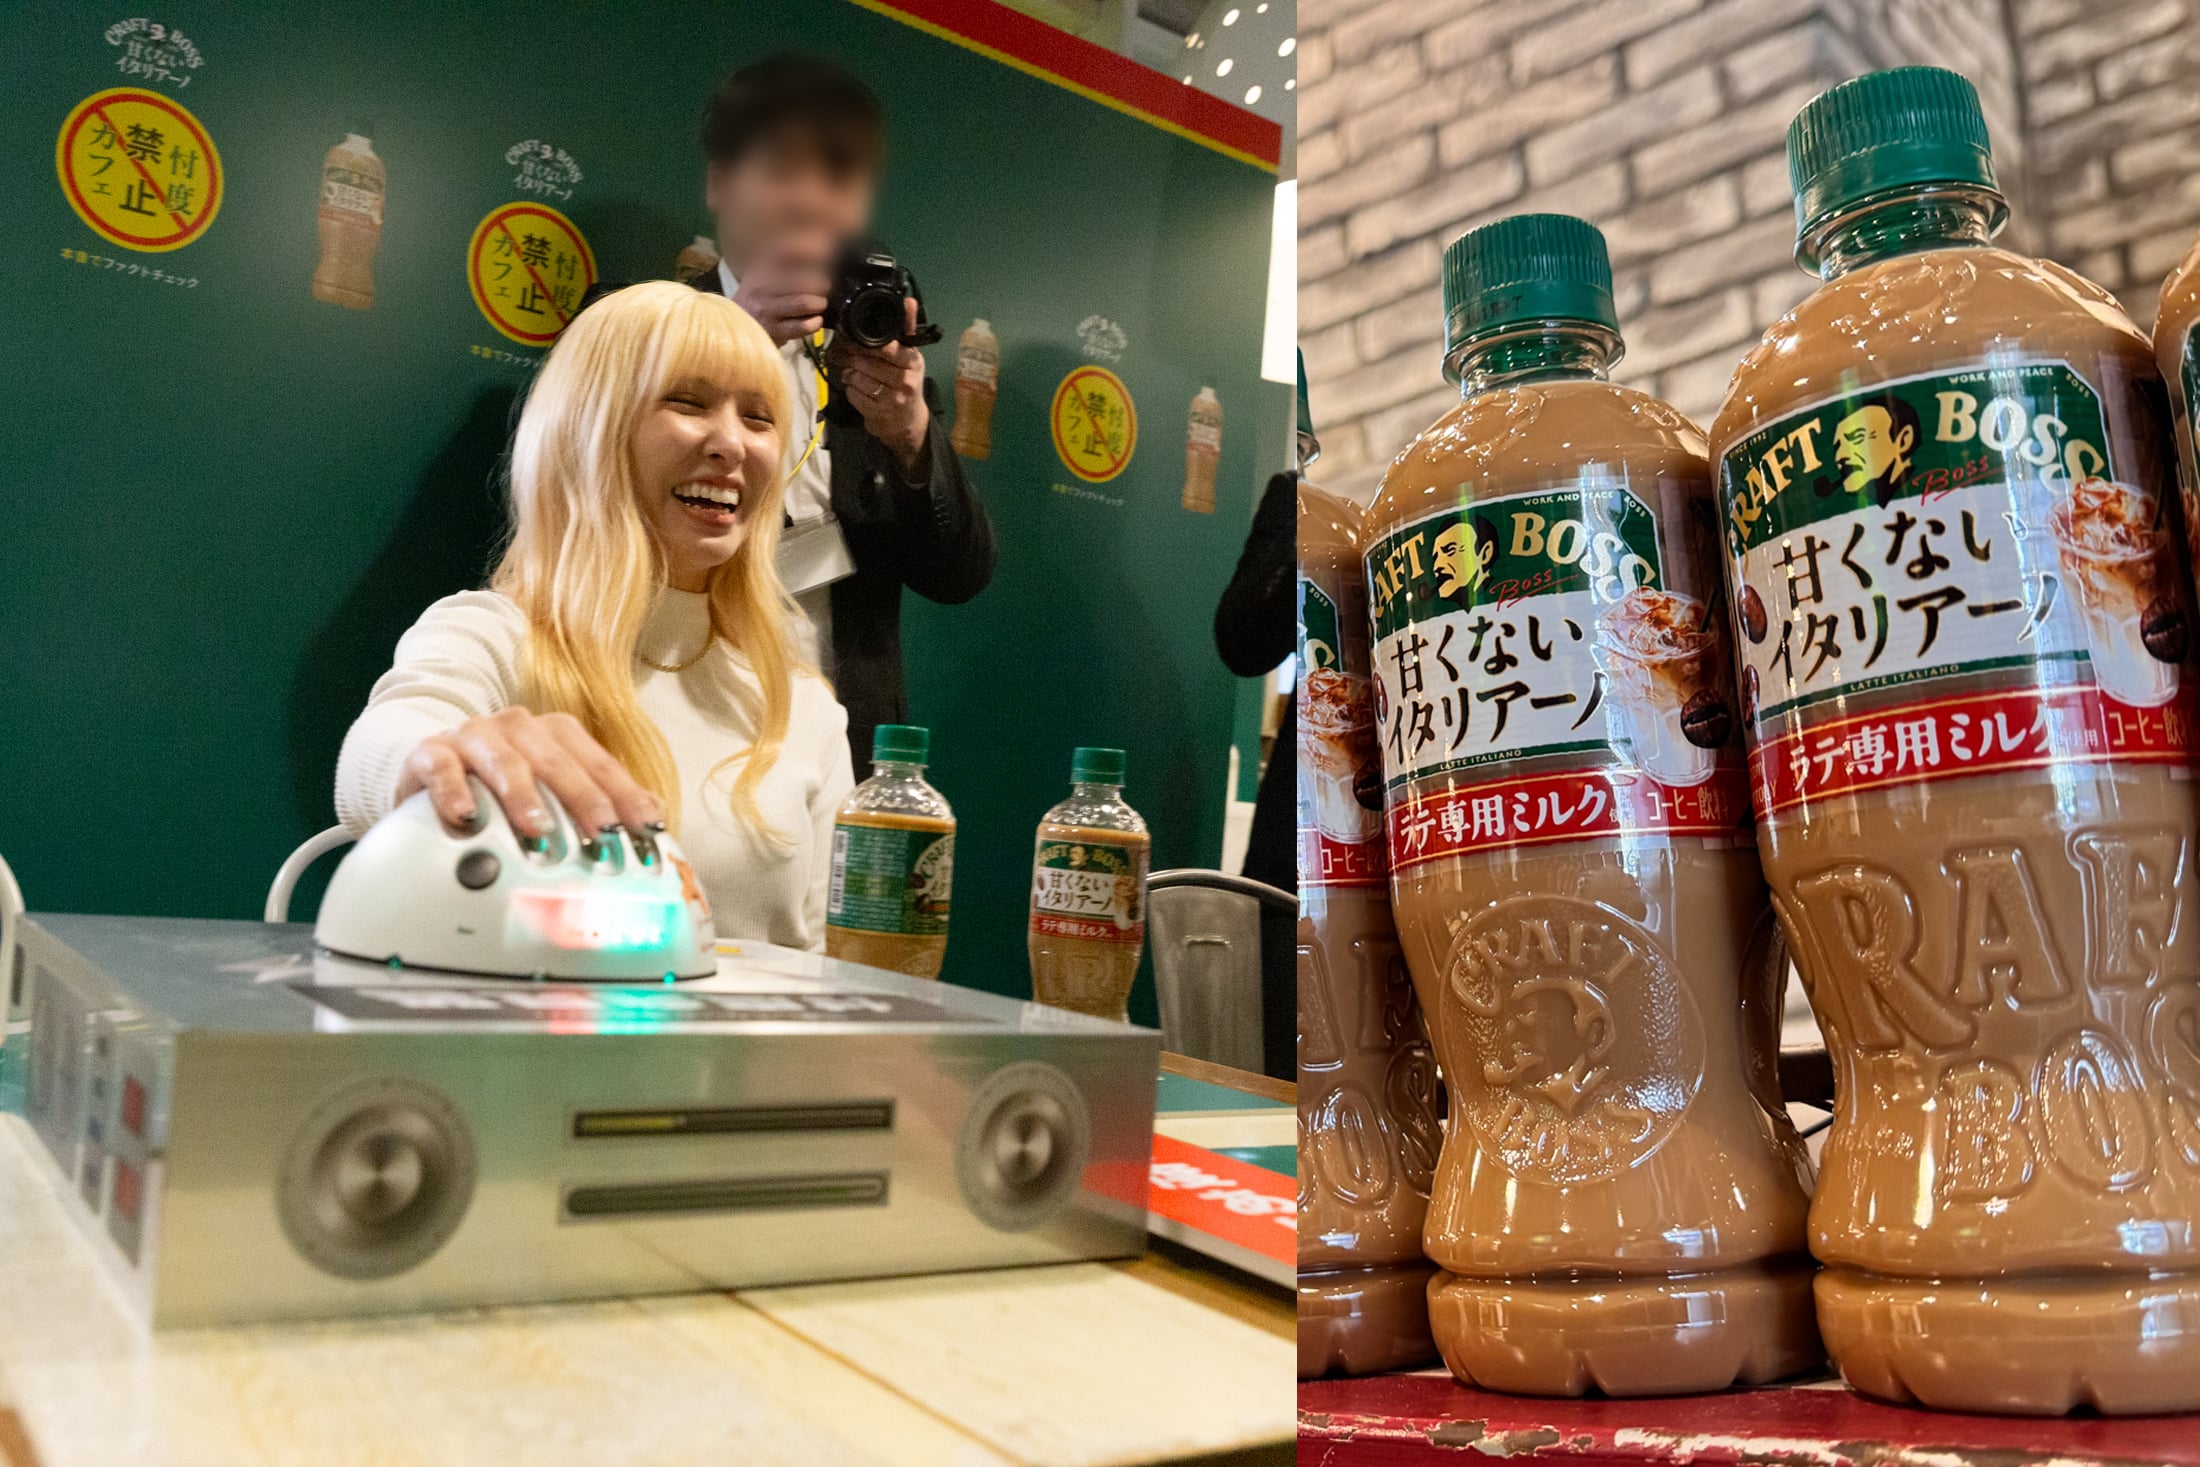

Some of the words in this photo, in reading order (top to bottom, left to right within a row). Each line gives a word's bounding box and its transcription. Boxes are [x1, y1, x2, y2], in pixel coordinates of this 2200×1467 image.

[88, 120, 118, 196] カフェ
[118, 122, 165, 217] 禁止
[515, 232, 552, 316] 禁止
[1949, 373, 1986, 385] WORK
[1988, 368, 2015, 381] AND
[2019, 367, 2054, 378] PEACE
[1935, 390, 2105, 496] BOSS
[1523, 495, 1553, 506] WORK
[1556, 492, 1580, 502] AND
[1509, 511, 1656, 605] BOSS
[1389, 614, 1585, 699] 甘くない
[1768, 571, 2059, 686] イタリアーノ
[1850, 677, 1888, 692] LATTE
[1893, 663, 1960, 683] ITALIANO
[1388, 671, 1610, 766] イタリアーノ
[1440, 758, 1468, 771] LATTE
[1471, 749, 1523, 765] ITALIANO
[1043, 889, 1113, 912] イタリアーノ
[1050, 870, 1110, 892] 甘くない
